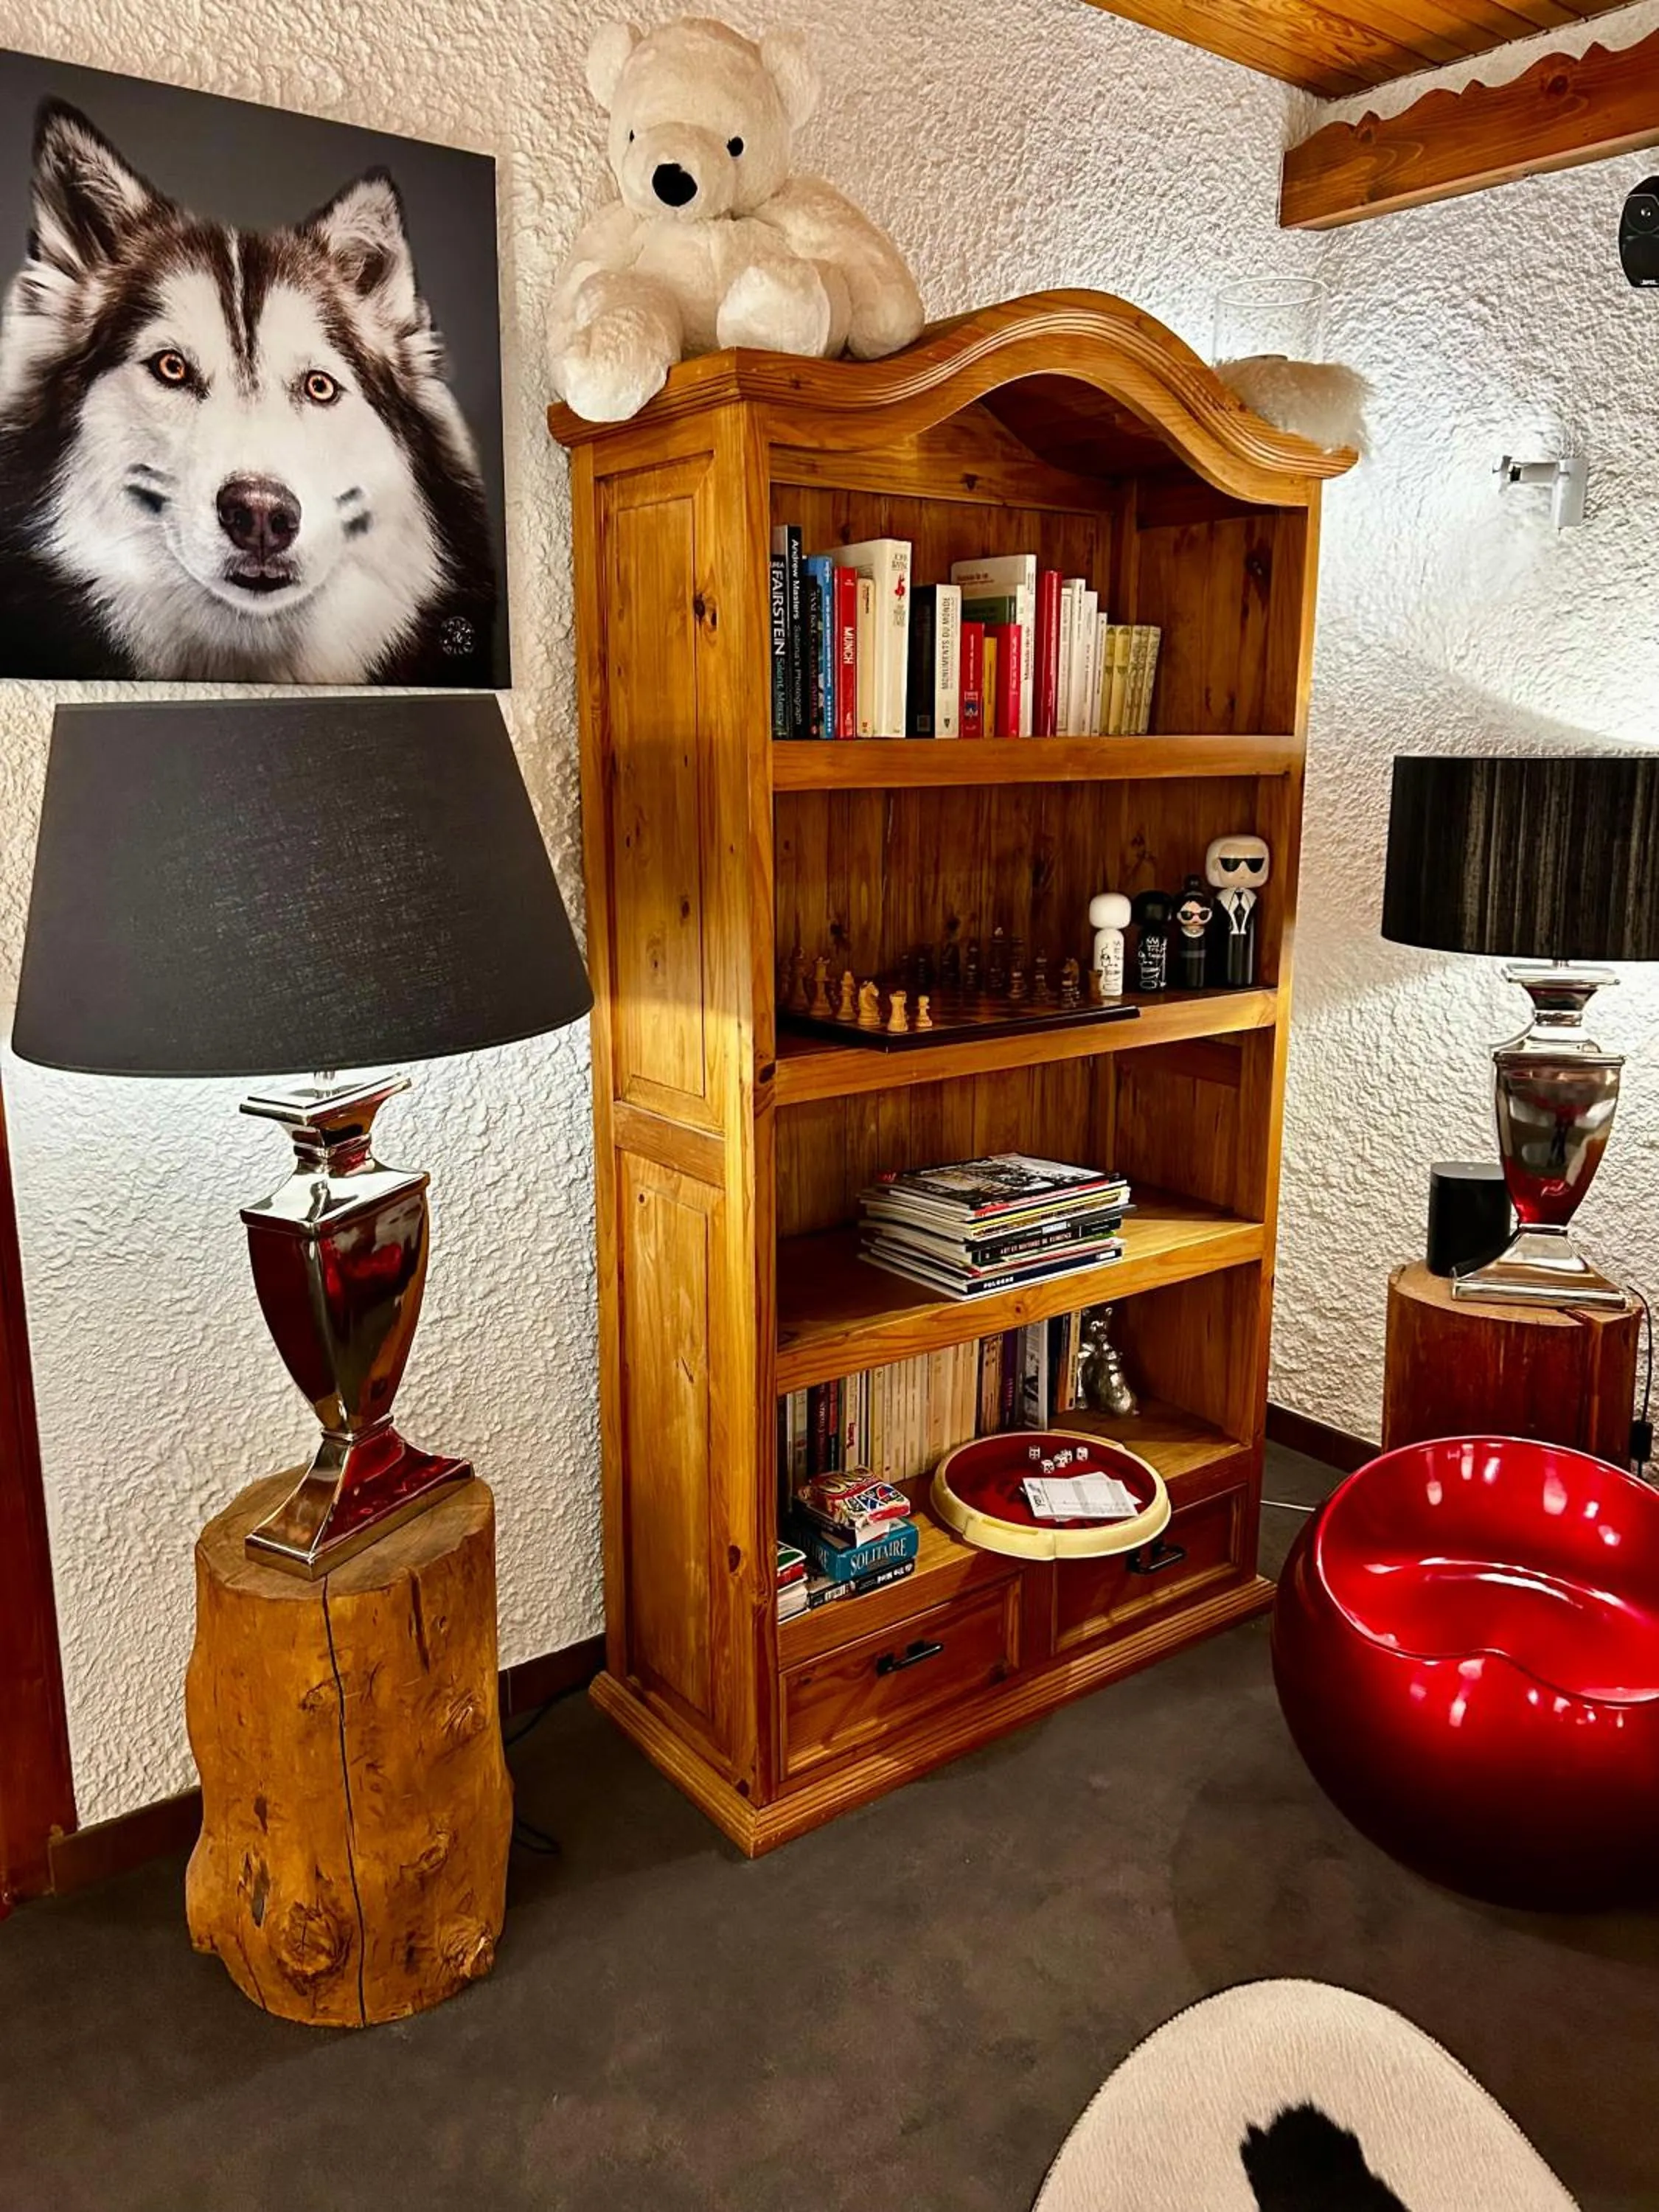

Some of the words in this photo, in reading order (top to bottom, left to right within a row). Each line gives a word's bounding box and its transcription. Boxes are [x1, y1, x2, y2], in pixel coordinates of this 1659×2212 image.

[792, 540, 801, 577] Andrew
[772, 570, 785, 655] FAIRSTEIN
[793, 581, 801, 619] Masters
[793, 625, 802, 667] Sabina's
[844, 627, 853, 664] MUNCH
[941, 640, 950, 689] MONUMENTS
[776, 658, 785, 687] Silent
[793, 669, 803, 725] Photograph
[850, 1537, 908, 1576] SOLITAIRE
